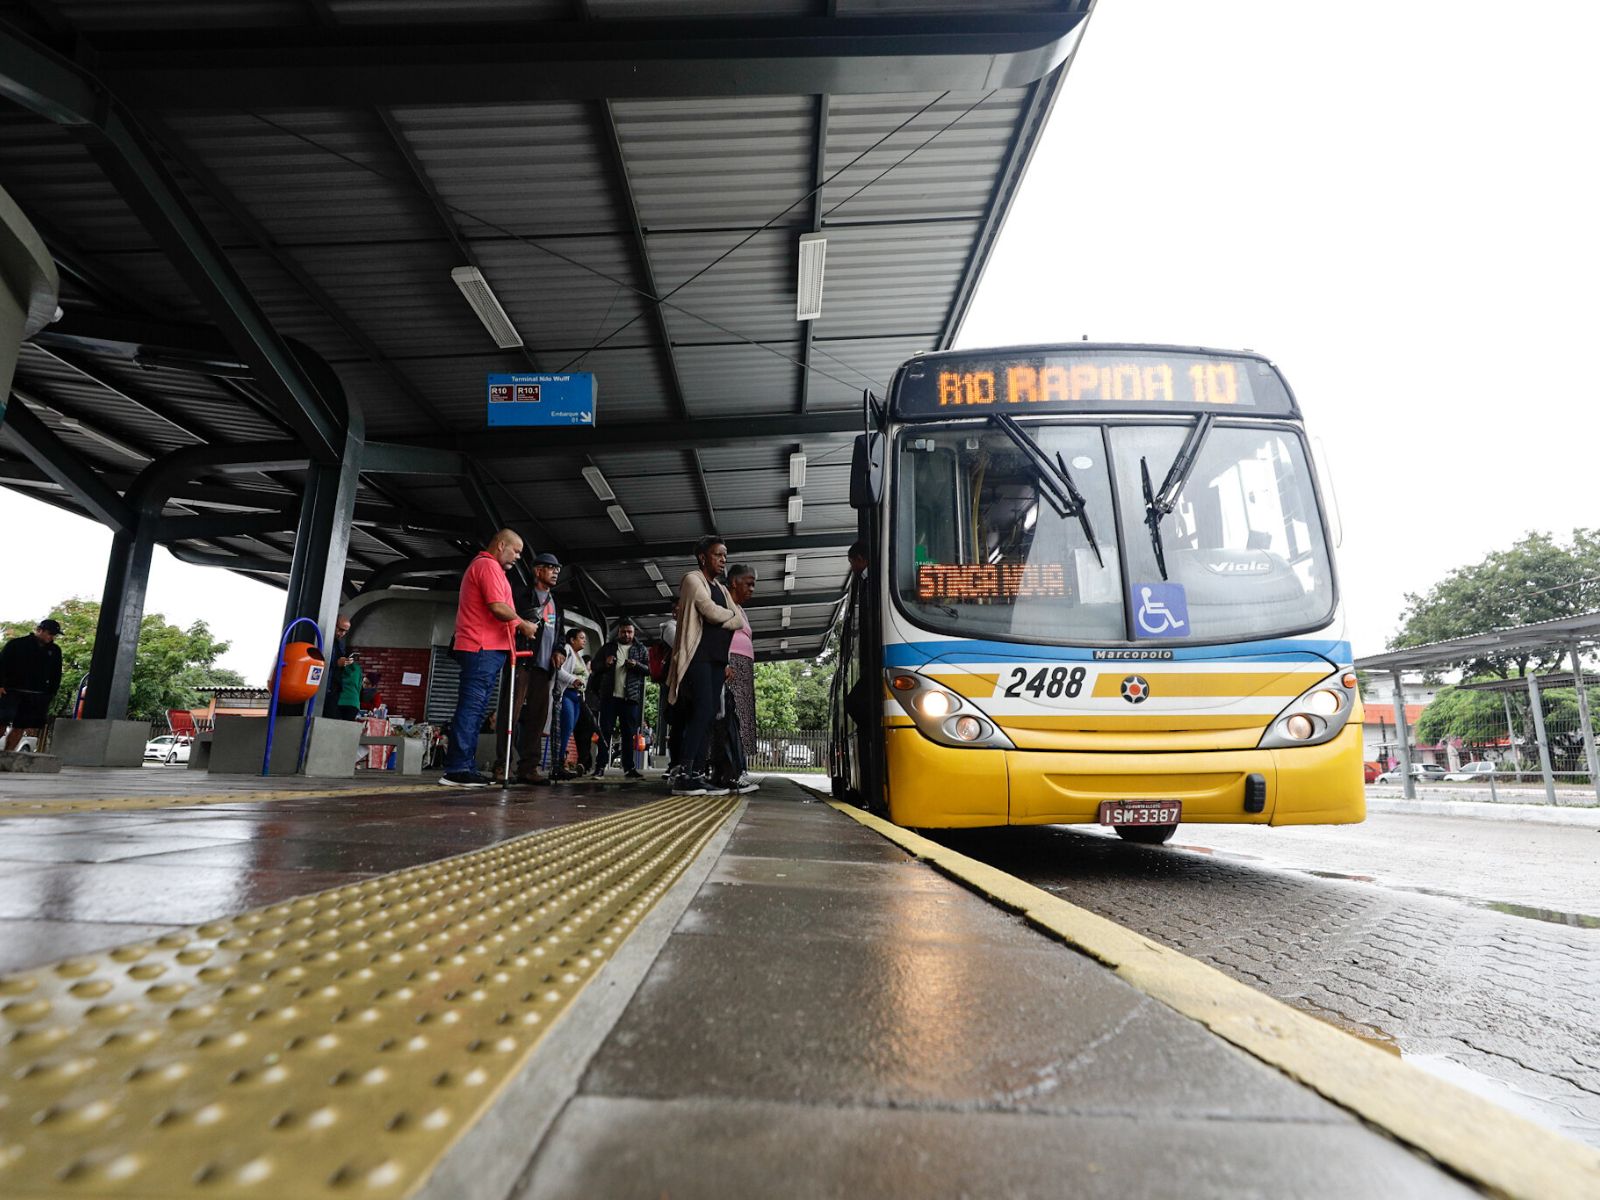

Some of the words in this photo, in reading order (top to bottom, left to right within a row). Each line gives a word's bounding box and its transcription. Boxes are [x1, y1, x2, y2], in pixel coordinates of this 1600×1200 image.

[1006, 363, 1173, 403] RAPIDA
[1189, 361, 1237, 404] 10
[1096, 650, 1172, 659] Marcopolo
[1004, 666, 1087, 699] 2488
